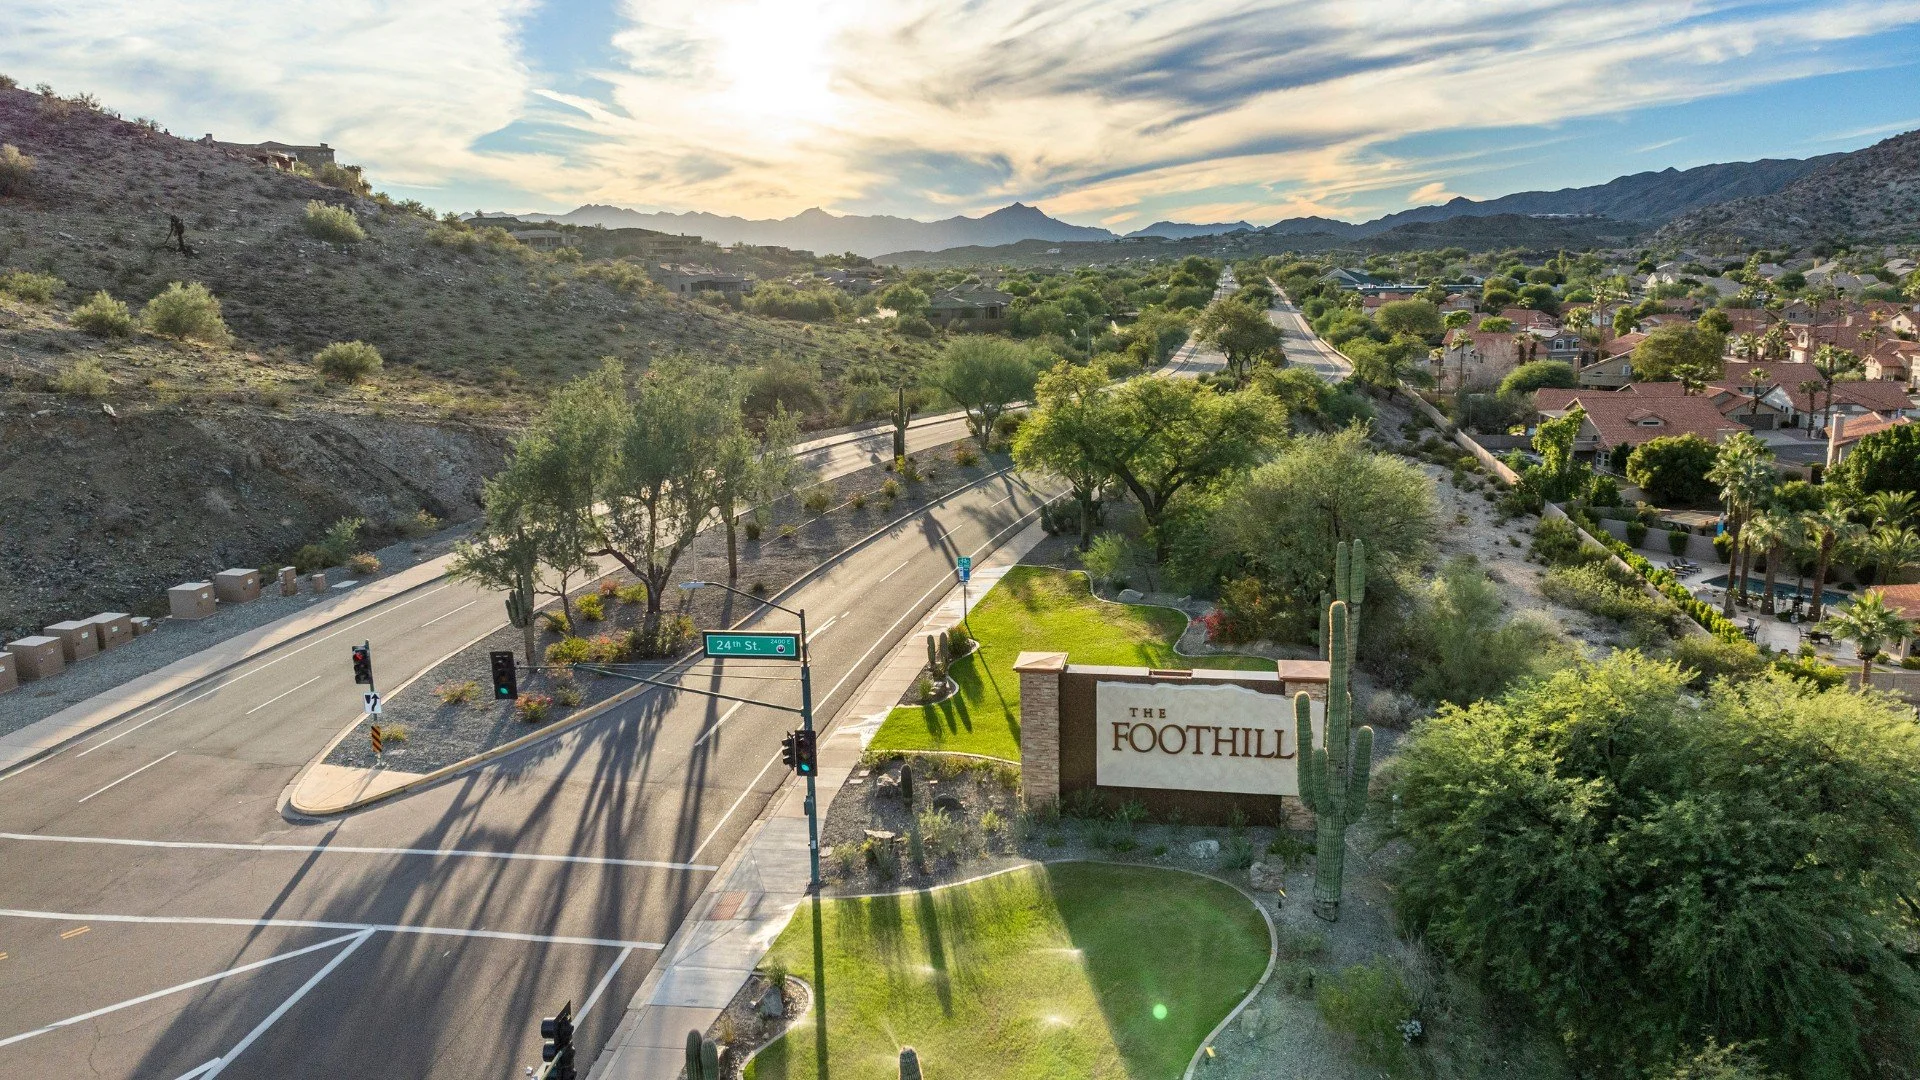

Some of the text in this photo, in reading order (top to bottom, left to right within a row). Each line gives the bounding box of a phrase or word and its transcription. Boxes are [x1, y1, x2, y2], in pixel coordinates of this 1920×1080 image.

[716, 640, 761, 651] 24th St.
[1129, 707, 1167, 719] THE
[1111, 721, 1296, 760] FOOTHILL
